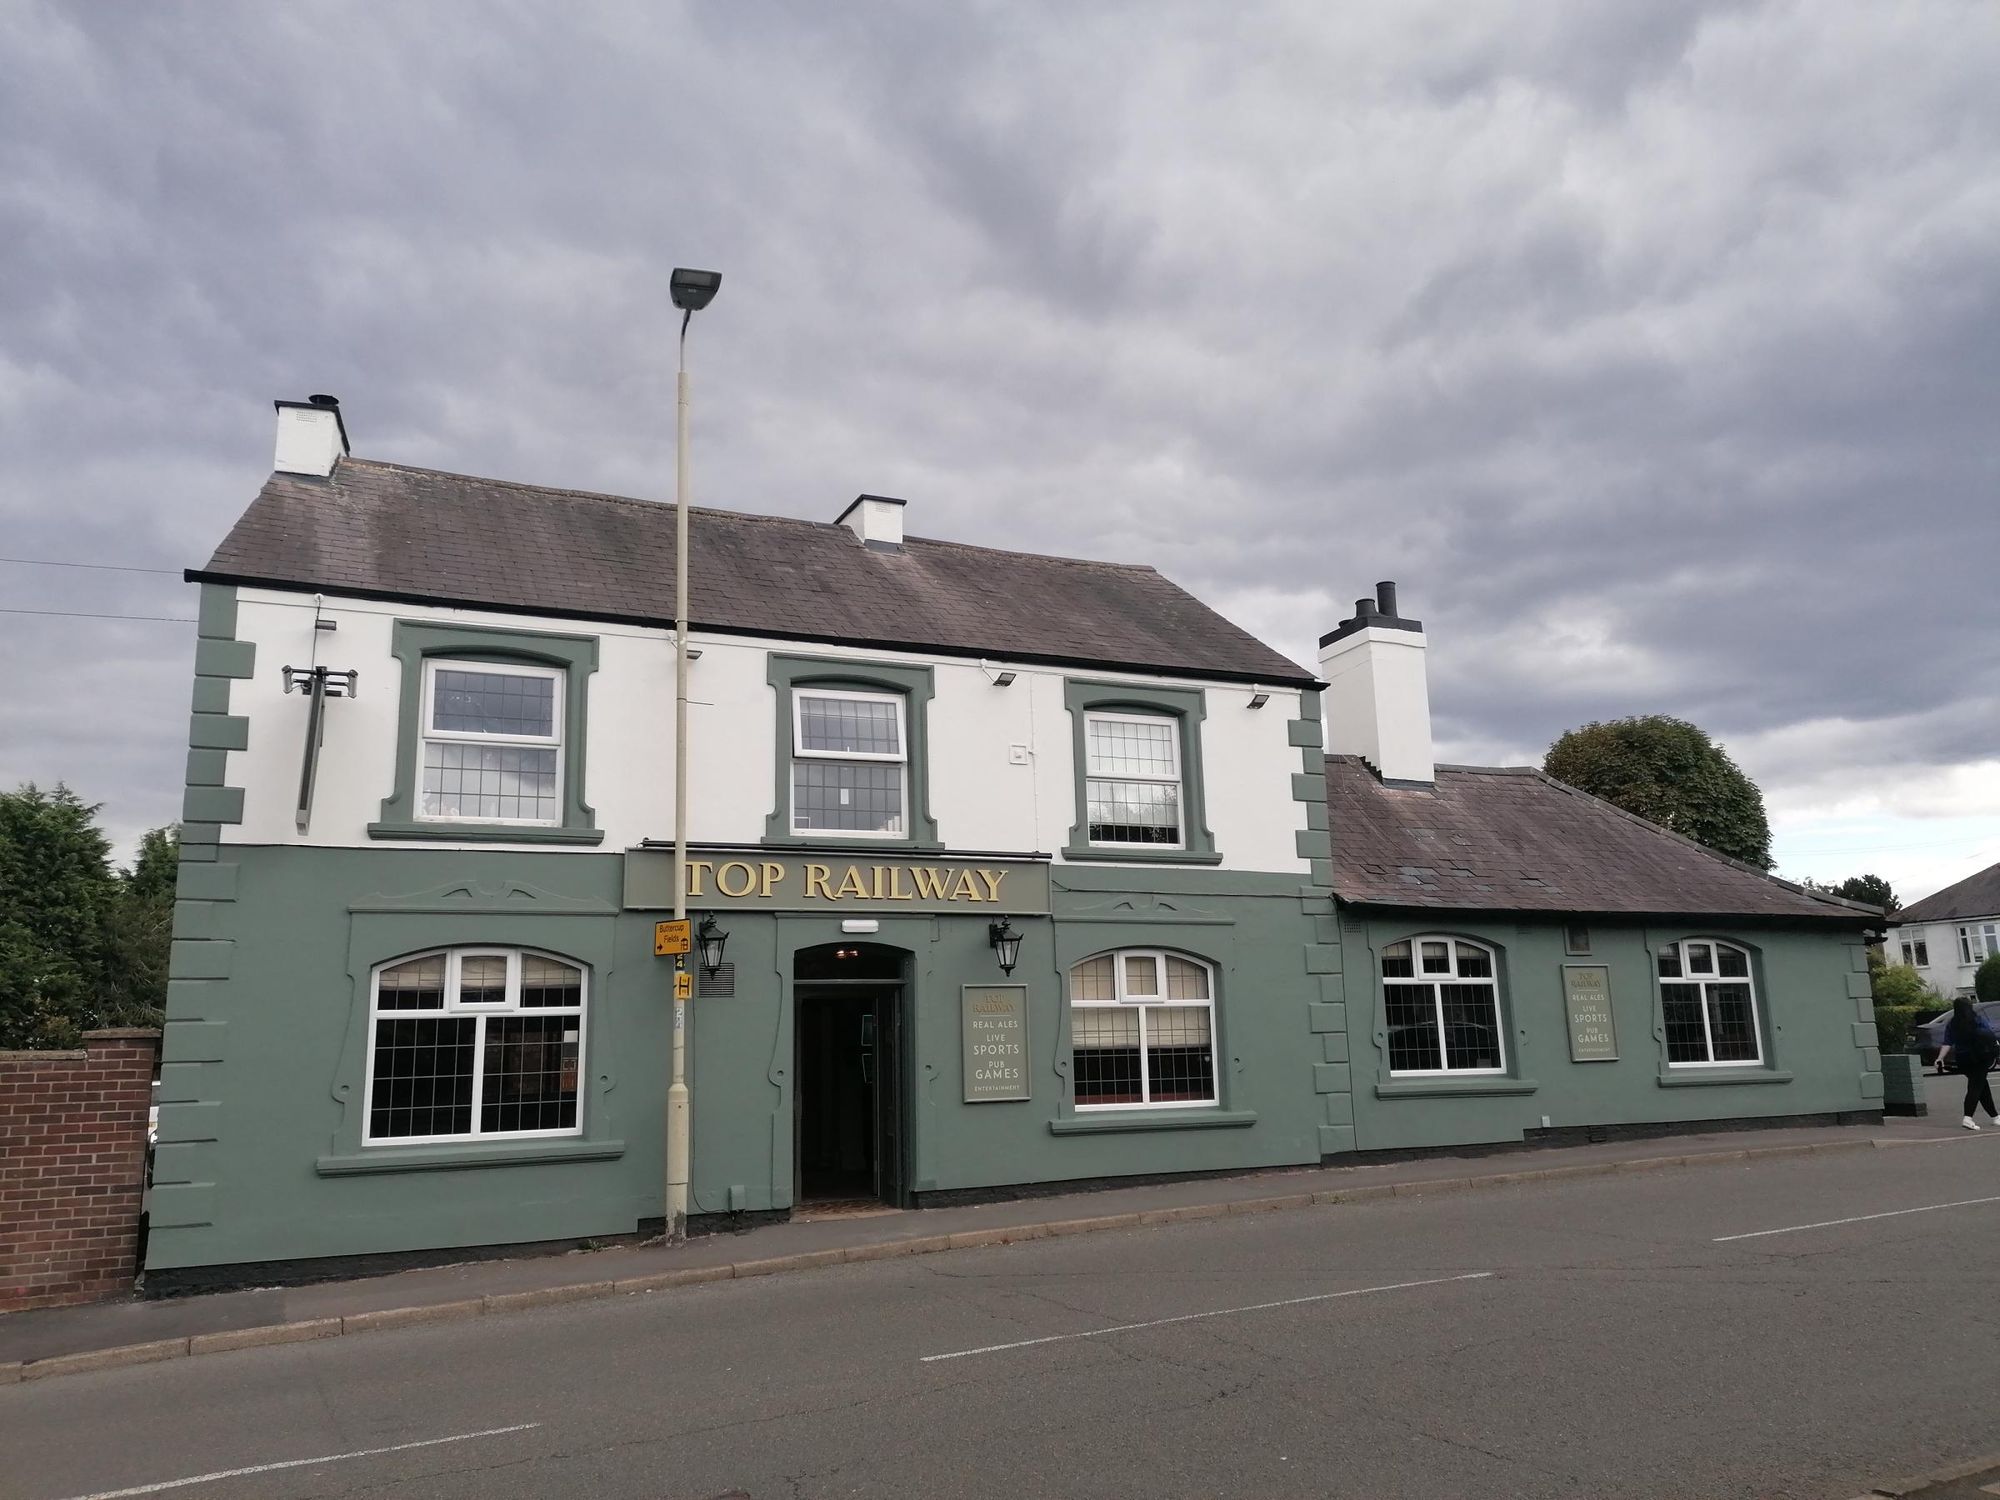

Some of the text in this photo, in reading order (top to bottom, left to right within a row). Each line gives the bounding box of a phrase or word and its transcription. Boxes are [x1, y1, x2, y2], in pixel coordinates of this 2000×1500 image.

[685, 861, 1009, 902] TOP RAILWAY
[660, 925, 684, 933] Buttercup
[664, 935, 679, 943] Fields
[678, 976, 691, 996] H
[1574, 1013, 1607, 1023] SPORTS
[973, 1020, 1018, 1029] REAL ALES
[986, 1034, 1006, 1042] LIVE
[1577, 1034, 1609, 1043] GAMES
[973, 1044, 1019, 1055] SPORTS
[988, 1061, 1005, 1069] PUB
[975, 1068, 1019, 1080] GAMES
